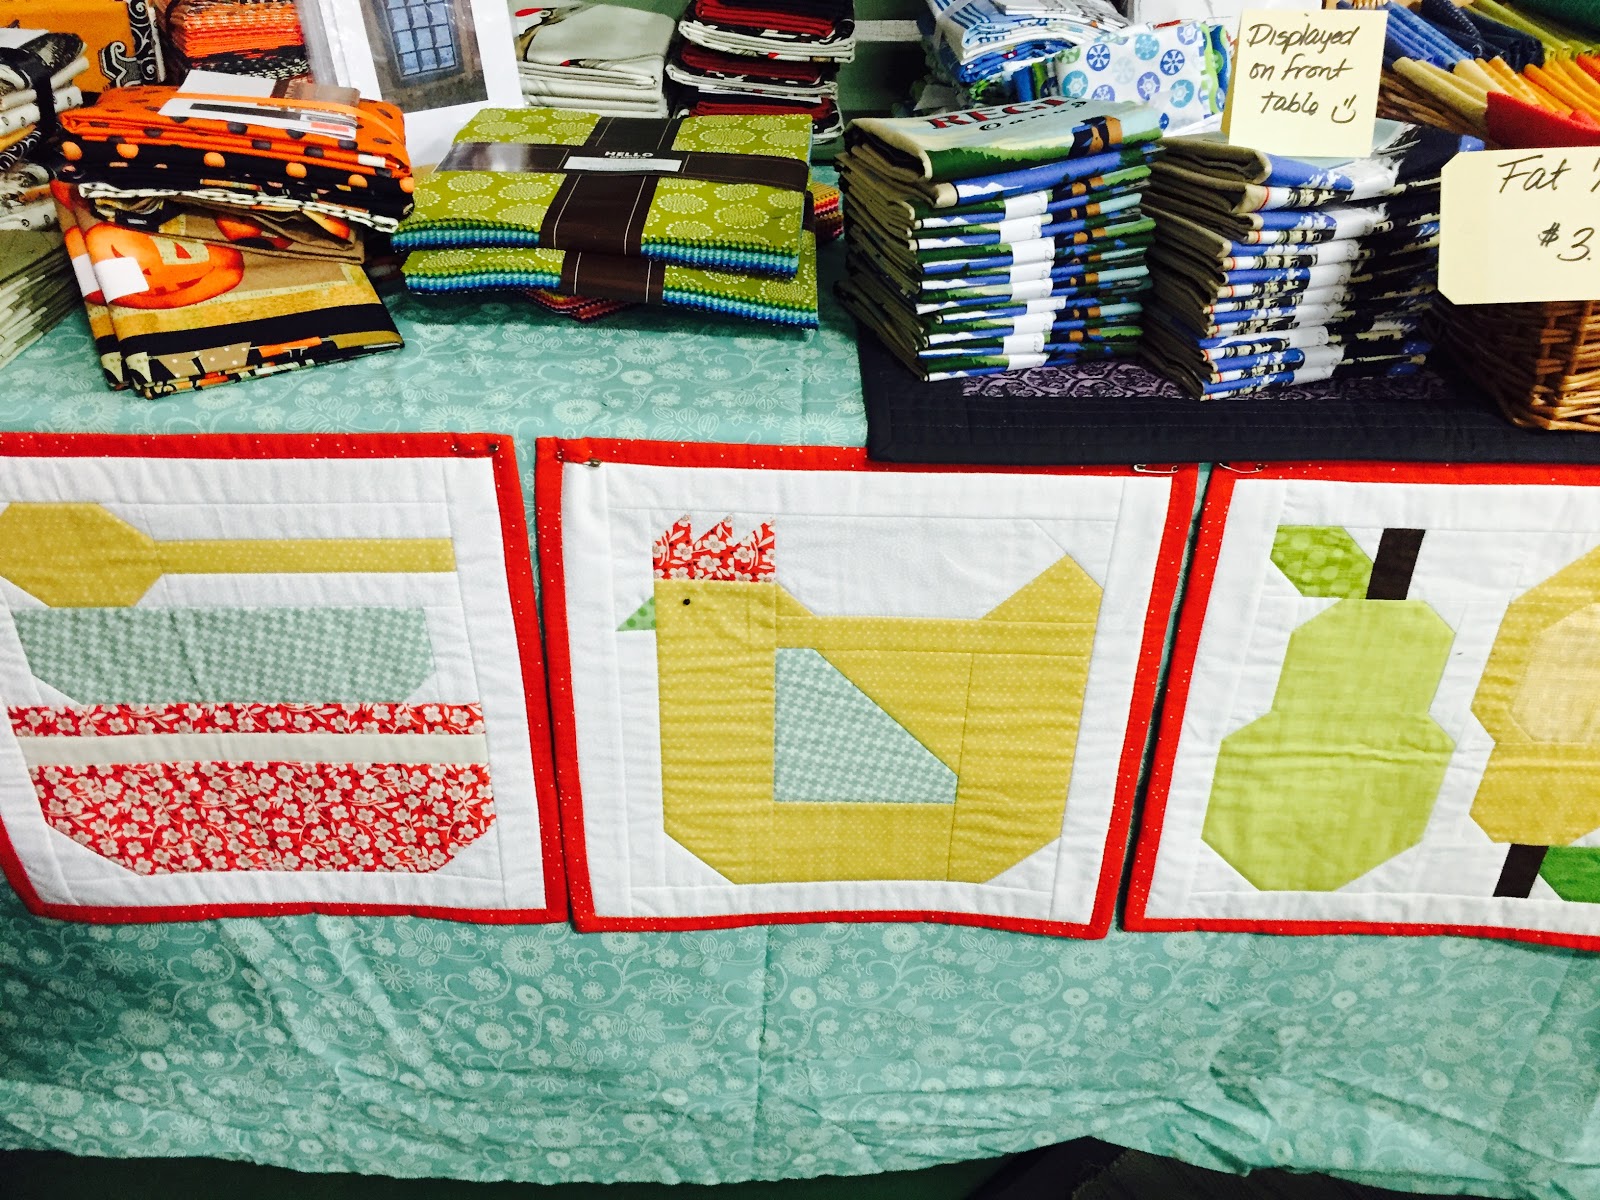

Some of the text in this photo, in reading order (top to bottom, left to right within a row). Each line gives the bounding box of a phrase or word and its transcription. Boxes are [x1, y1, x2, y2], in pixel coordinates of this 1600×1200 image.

[1246, 22, 1360, 54] Displayed
[1248, 53, 1354, 81] on front
[1260, 91, 1319, 116] table
[1497, 154, 1572, 194] Fat
